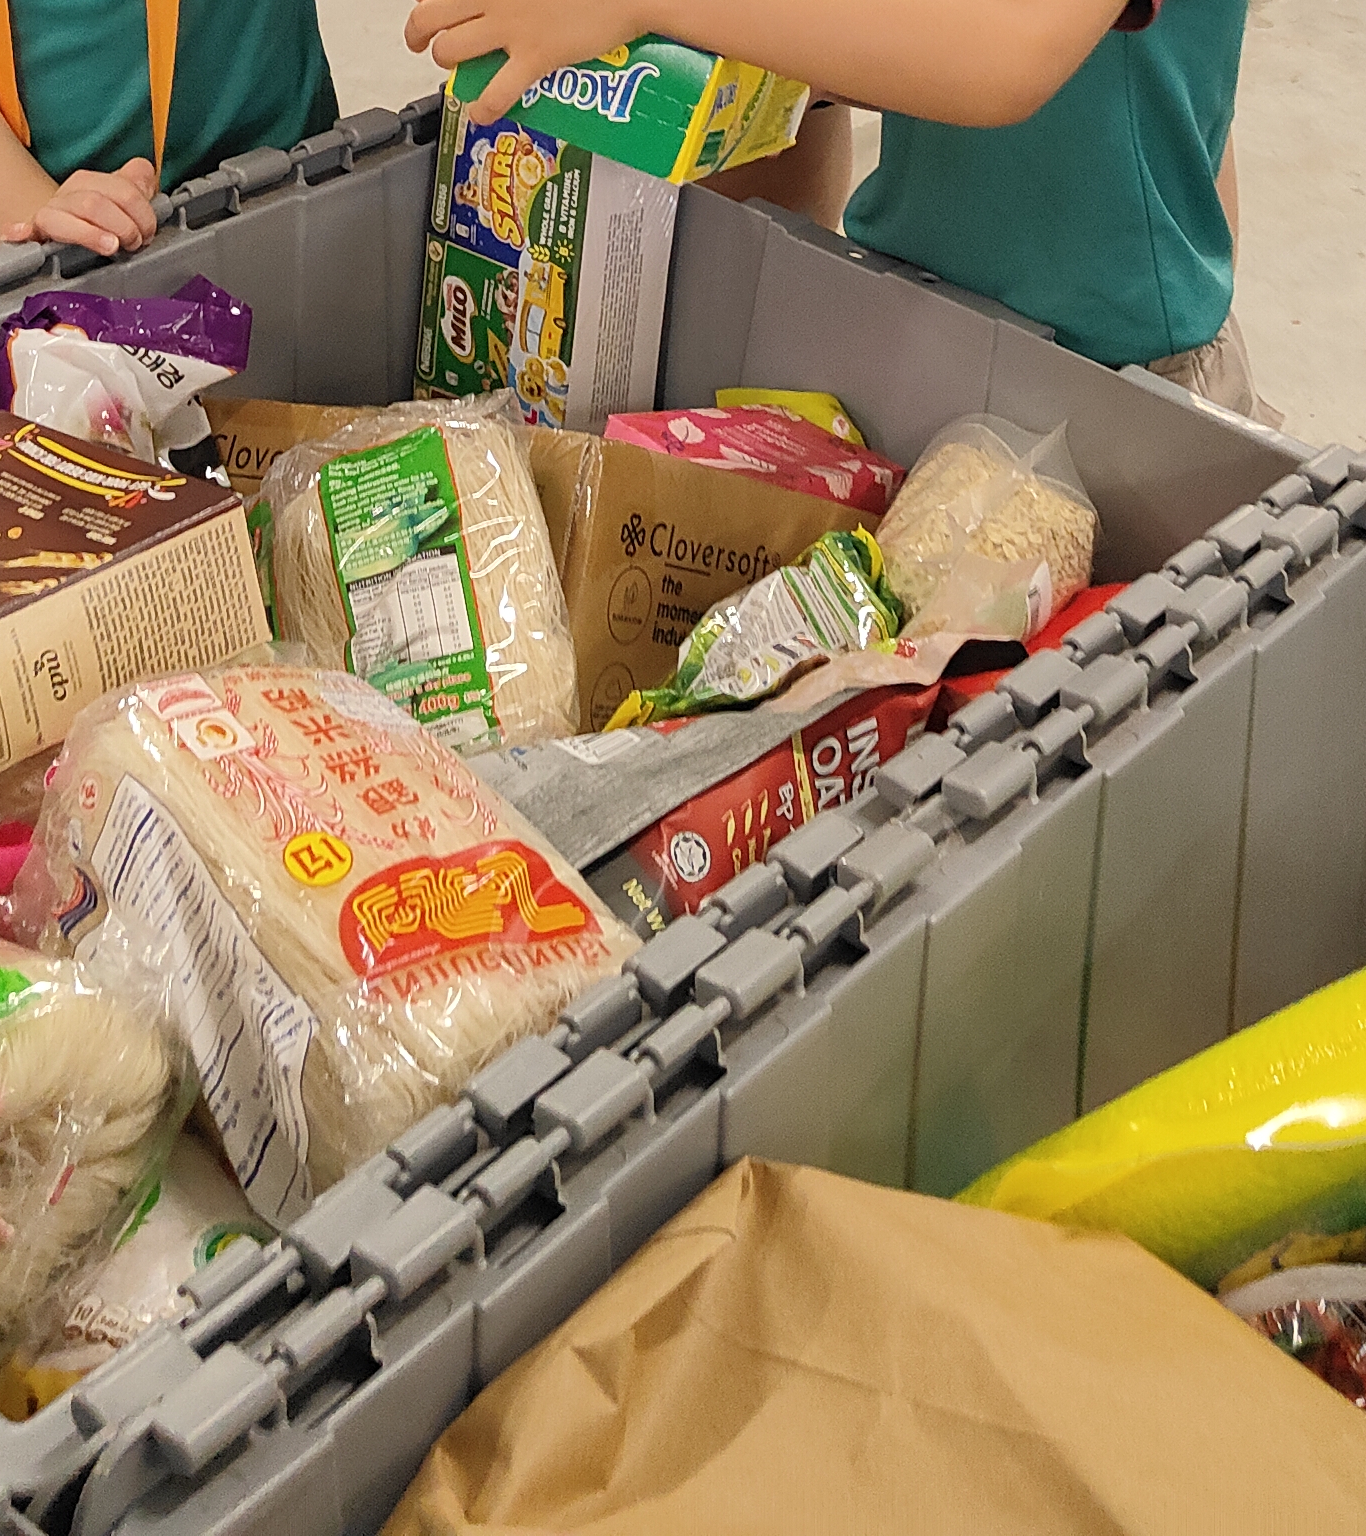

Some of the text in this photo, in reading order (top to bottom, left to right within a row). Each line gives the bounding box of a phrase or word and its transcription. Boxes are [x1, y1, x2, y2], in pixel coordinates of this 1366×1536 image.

[491, 134, 524, 248] STARS
[450, 285, 467, 352] MILO
[649, 522, 773, 583] Cloversoft
[661, 575, 683, 596] the
[656, 601, 704, 625] mome
[418, 692, 460, 715] 400g
